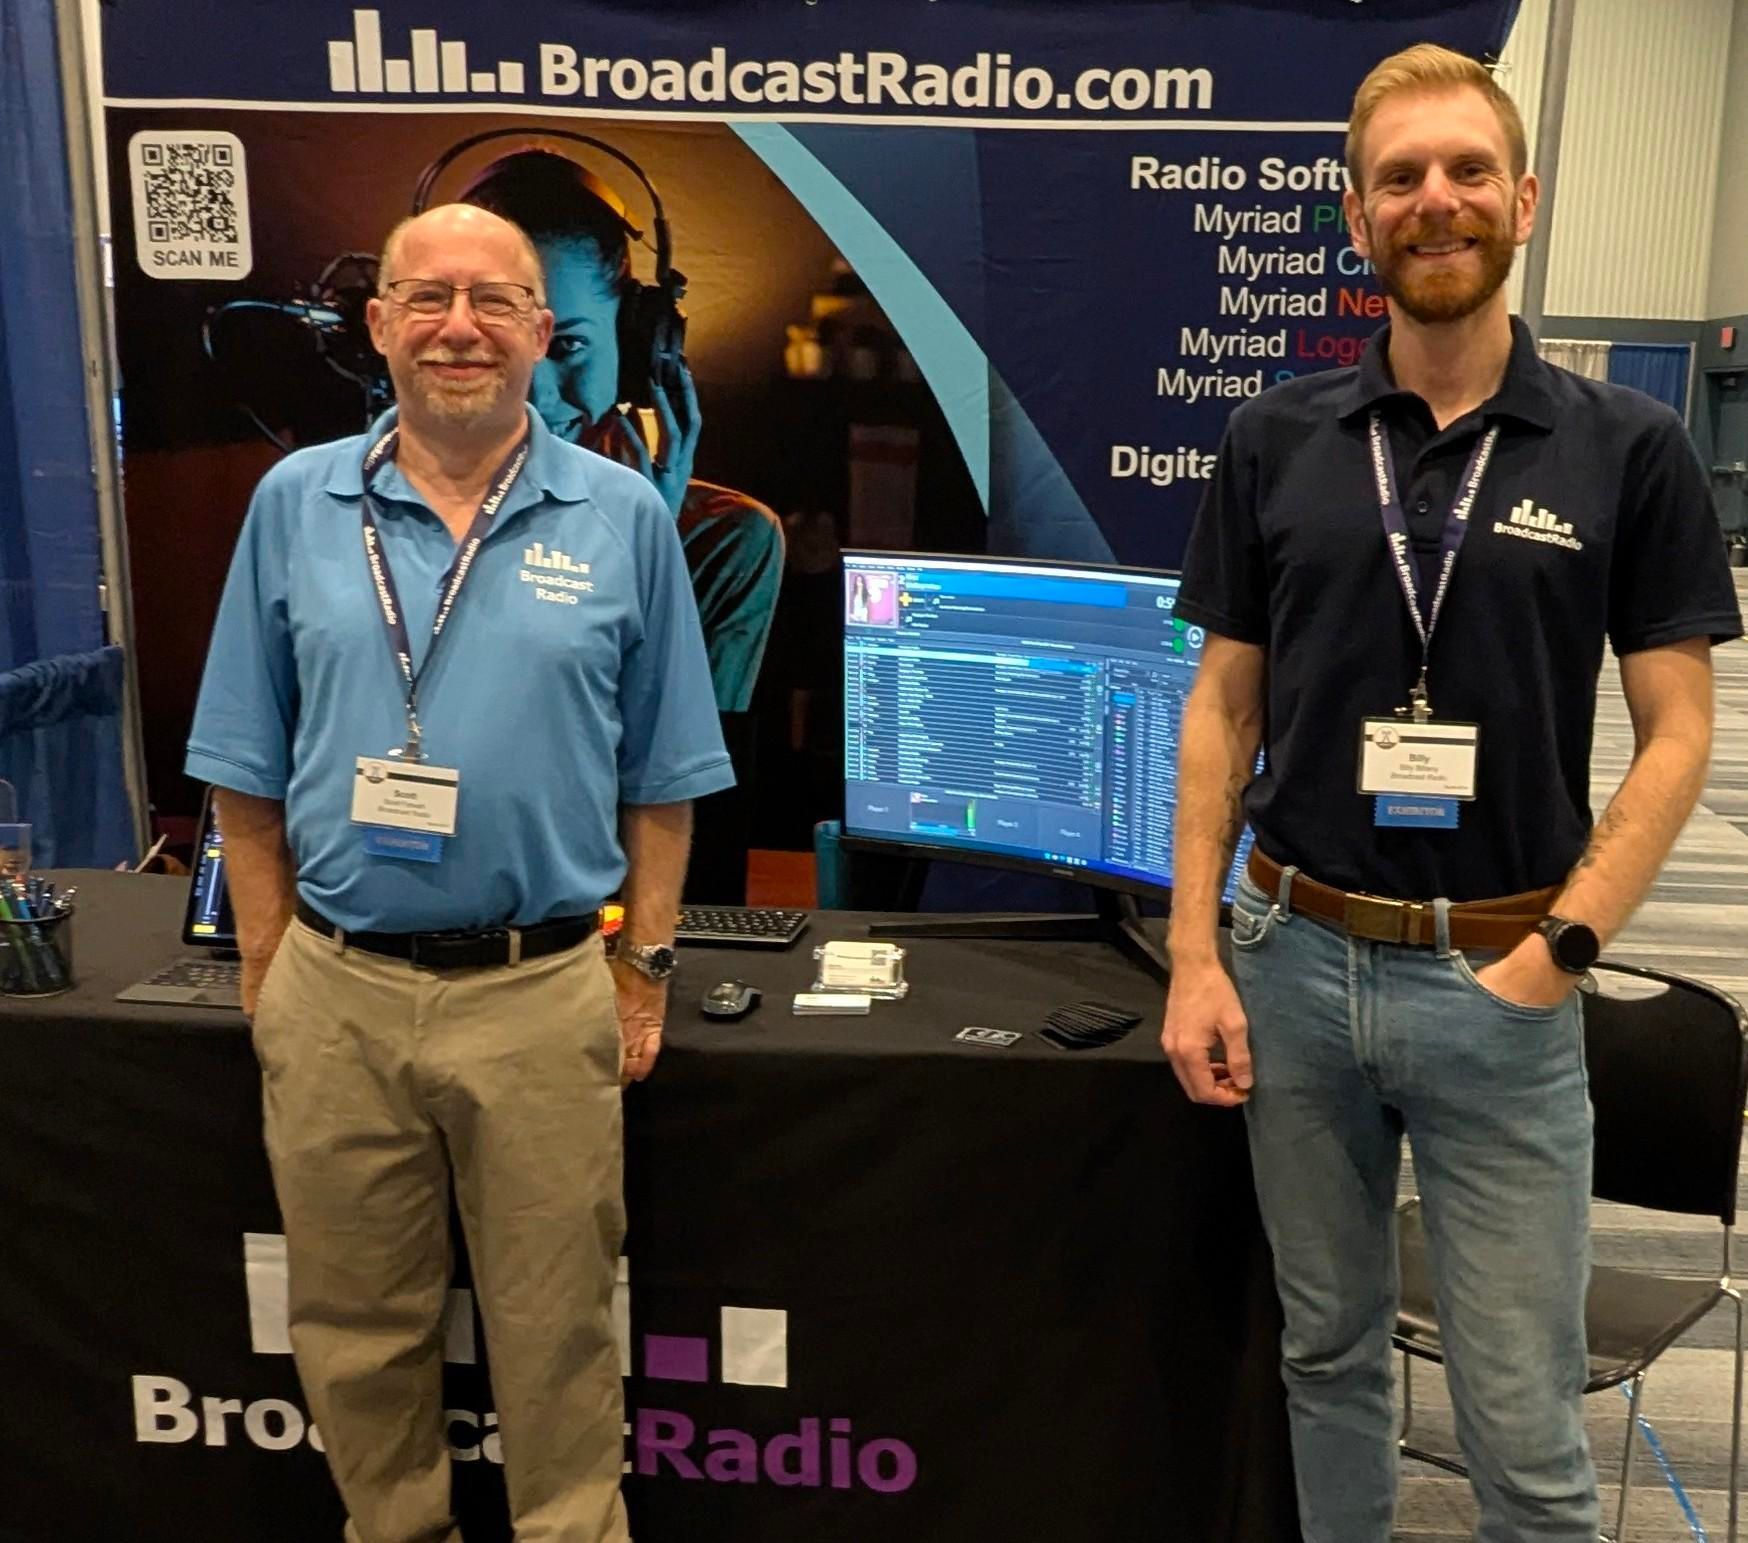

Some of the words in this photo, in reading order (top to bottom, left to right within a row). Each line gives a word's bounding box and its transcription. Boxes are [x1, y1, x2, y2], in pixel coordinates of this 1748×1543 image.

[540, 43, 1213, 111] BroadcastRadio.com
[1130, 155, 1247, 191] Radio
[1193, 203, 1302, 241] Myriad
[1312, 204, 1349, 234] Pl
[153, 249, 203, 267] SCAN
[208, 250, 240, 268] ME
[1217, 245, 1326, 282] Myriad
[1336, 246, 1376, 276] Cl
[1219, 286, 1328, 323] Myriad
[1337, 287, 1389, 318] Ne
[1179, 327, 1287, 364] Myriad
[1156, 367, 1263, 404] Myriad
[1493, 521, 1582, 551] BroadcastRadio
[520, 569, 594, 592] Broadcast
[535, 587, 579, 605] Radio
